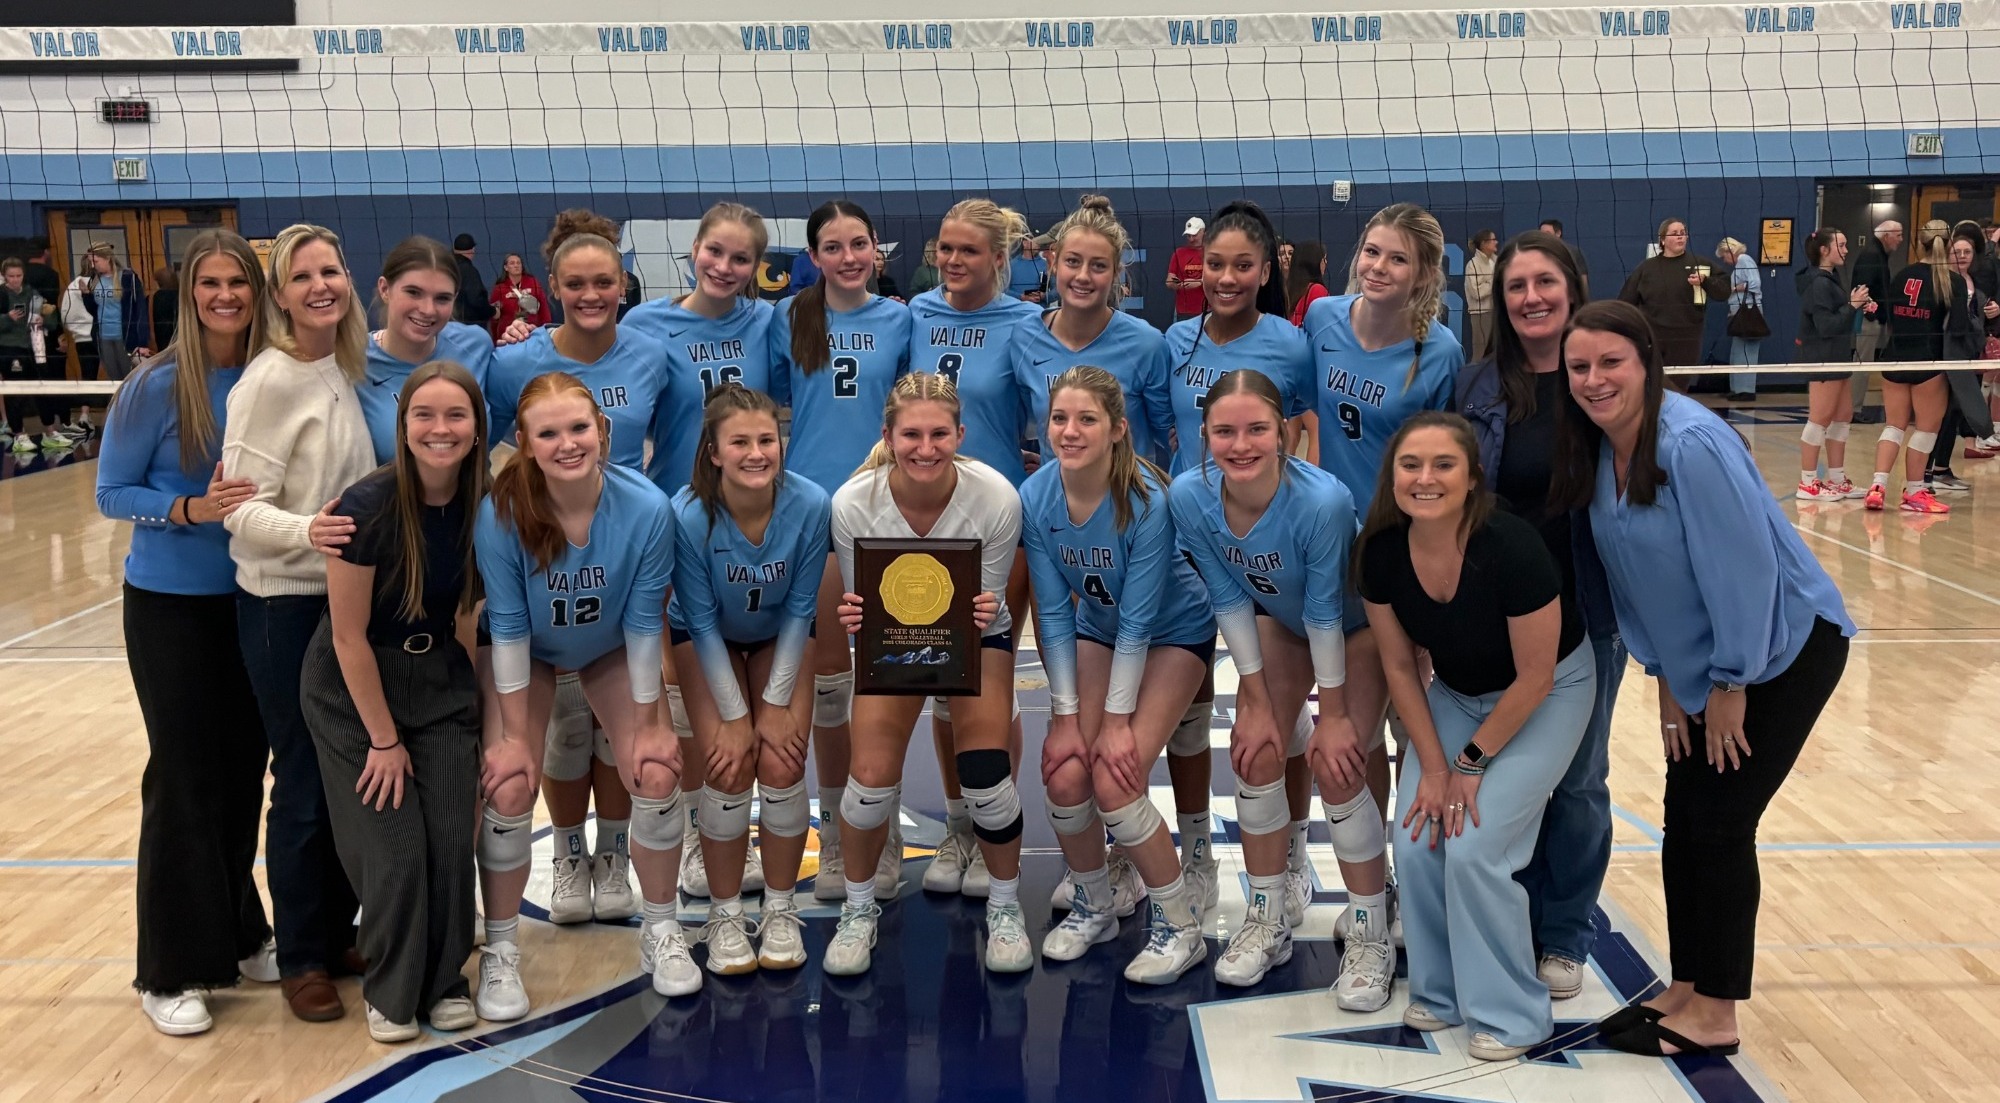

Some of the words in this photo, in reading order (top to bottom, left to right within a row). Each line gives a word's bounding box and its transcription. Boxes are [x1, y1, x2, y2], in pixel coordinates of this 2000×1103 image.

[32, 33, 99, 56] VALOR
[172, 32, 241, 56] VALOR
[315, 30, 382, 54] VALOR
[456, 29, 524, 53] VALOR
[600, 27, 667, 52] VALOR
[741, 26, 810, 51] VALOR
[883, 25, 952, 49] VALOR
[1026, 22, 1094, 47] VALOR
[1169, 20, 1237, 45] VALOR
[1312, 17, 1381, 41] VALOR
[1457, 13, 1525, 38] VALOR
[1601, 11, 1669, 36] VALOR
[1746, 7, 1814, 32] VALOR
[1892, 3, 1961, 28] VALOR
[1916, 136, 1940, 153] EXIT
[118, 161, 140, 177] EXIT
[1904, 278, 1923, 306] 4
[686, 339, 746, 363] VALOR
[827, 332, 876, 352] ALOR
[930, 326, 987, 349] VALOR
[832, 355, 859, 398] 2
[935, 353, 964, 388] 8
[1185, 365, 1231, 390] VAL
[699, 365, 744, 409] 16
[1326, 365, 1387, 409] VALOR
[1338, 401, 1362, 441] 9
[1059, 544, 1116, 569] VALOR
[1220, 545, 1284, 573] VALOR
[546, 565, 608, 595] VALOR
[726, 560, 786, 584] VALOR
[1244, 572, 1280, 595] 6
[745, 587, 763, 613] 1
[1083, 573, 1116, 607] 4
[551, 596, 601, 627] 12
[909, 628, 951, 636] QUALIFIER
